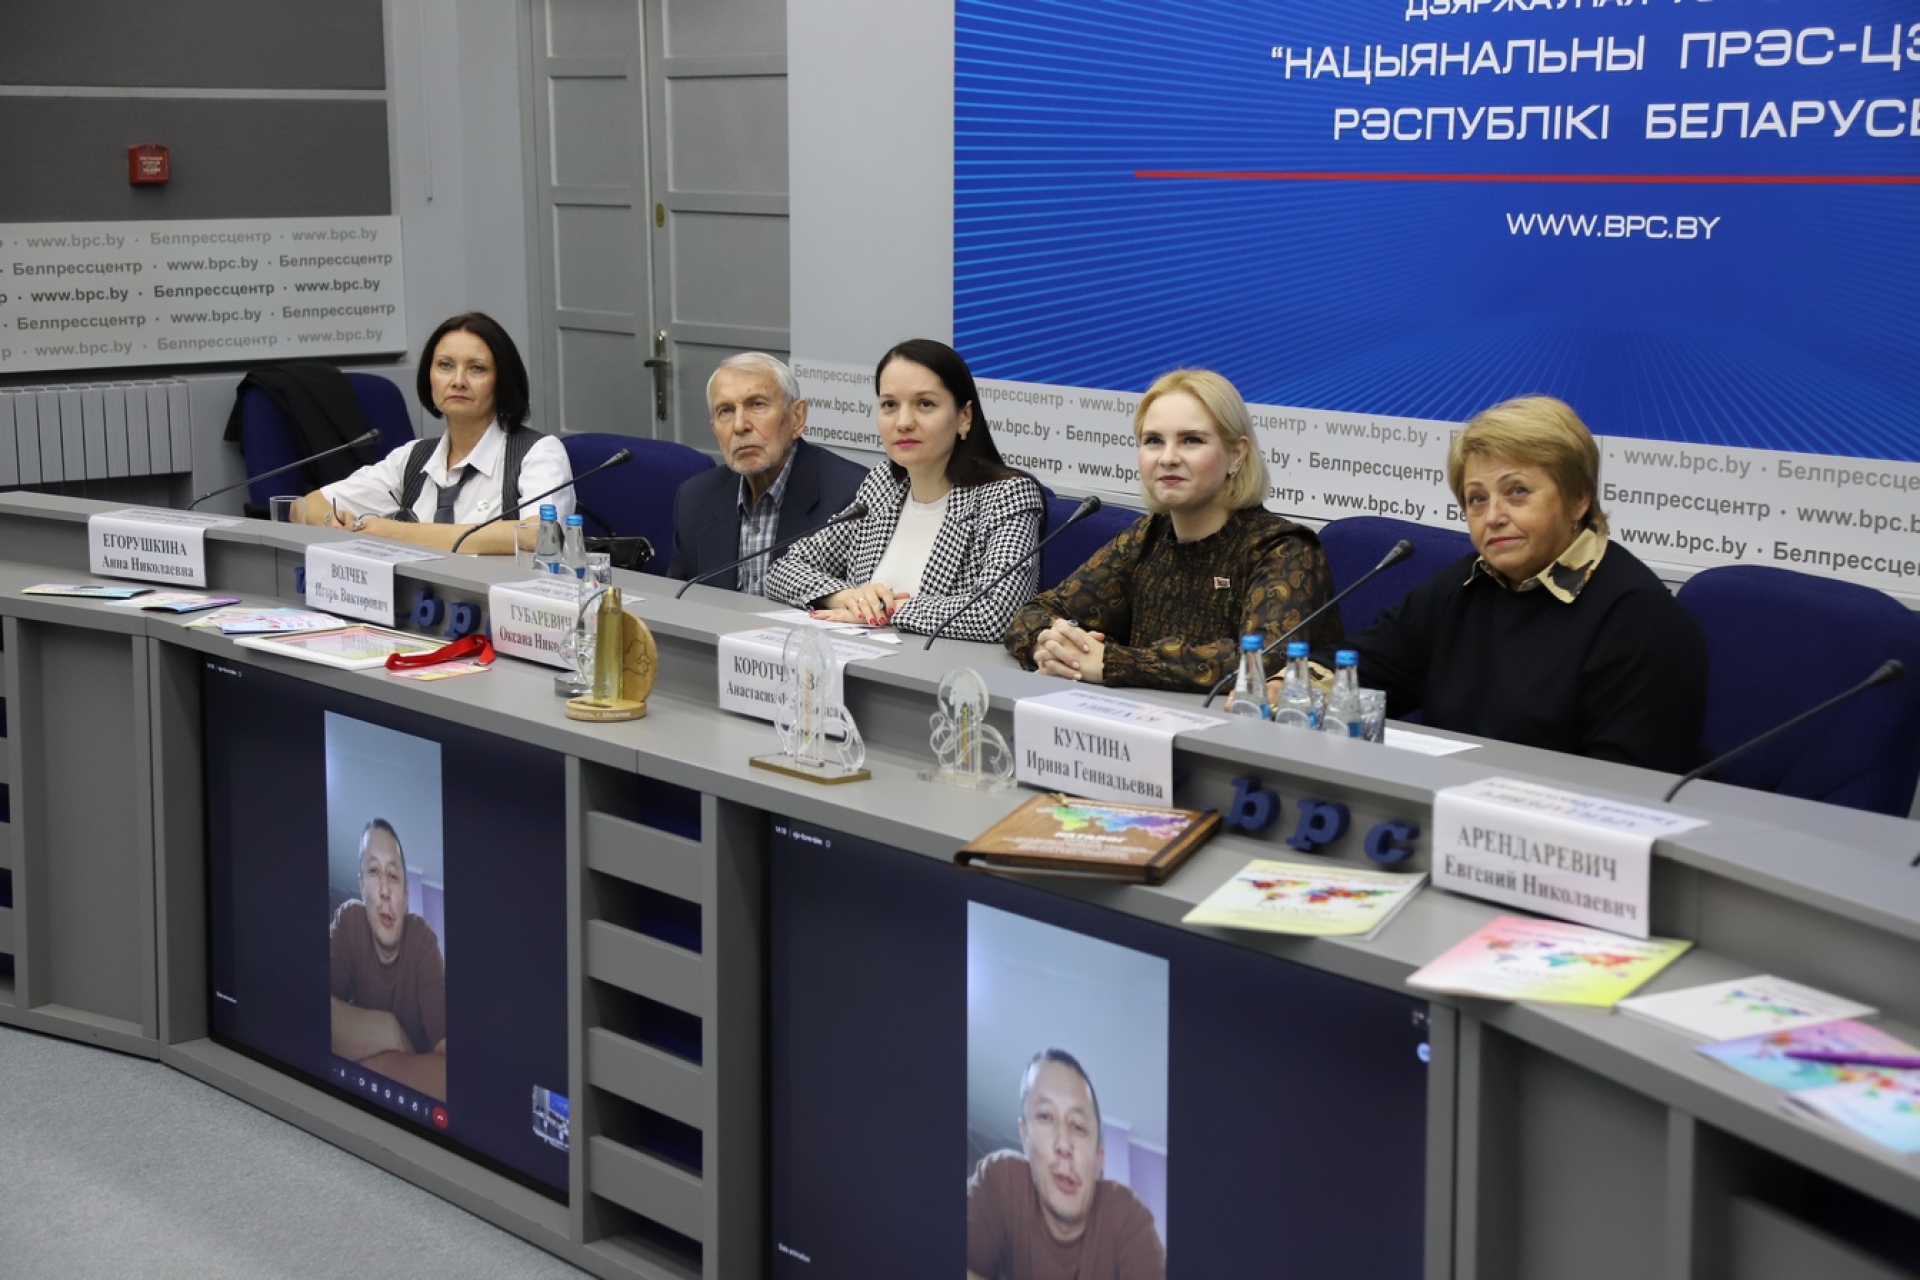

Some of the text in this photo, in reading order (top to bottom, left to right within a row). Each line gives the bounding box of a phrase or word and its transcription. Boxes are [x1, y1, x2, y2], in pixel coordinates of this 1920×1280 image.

[1334, 98, 1920, 141] РЭСПУБЛІКІ БЕЛАРУС
[27, 227, 378, 250] www.bpc.by Белпрессцентр www.bpc.by
[1506, 212, 1721, 240] WWW.BPC.BY
[13, 252, 393, 277] Белпрессцентр www.bpc.by Белпрессцентр
[30, 277, 381, 304] www.bpc.by Белпрессцентр www.bpc.by
[17, 304, 395, 331] Белпрессцентр www.bpc.by Белпрессцентр
[35, 327, 384, 358] www.bpc.by Белпрессцентр www.bpc.by
[794, 364, 877, 386] Белпрессцент
[977, 386, 1064, 409] лпрессцентр
[1080, 395, 1140, 416] www.bp
[1326, 420, 1428, 447] www.bpc.by
[1624, 449, 1751, 479] www.bpc.by
[1778, 459, 1920, 493] Белпрессце
[1066, 425, 1141, 448] Белпресс
[1309, 451, 1444, 484] Белпрессцентр
[1604, 483, 1771, 521] Белпрессцентр
[1797, 505, 1920, 534] www.bpc.b
[803, 426, 884, 447] елпрессцентр
[1323, 491, 1425, 520] www.bpc.by
[1621, 527, 1747, 560] www.bpc.by
[1774, 541, 1920, 578] Белпрессце
[103, 533, 188, 557] ЕГОРУШКИНА
[102, 556, 194, 578] Анна Николаевна
[331, 563, 368, 585] ВОЛЧЕК
[315, 582, 388, 614] Игорь Викторович
[499, 626, 533, 646] Оксана
[1053, 726, 1131, 763] КУХТИНА
[1026, 749, 1164, 799] Ирина Геннадьевна
[1457, 825, 1617, 882] АРЕНДАРЕВИЧ
[1445, 854, 1517, 890] Евгений
[1522, 873, 1637, 921] Николаевич
